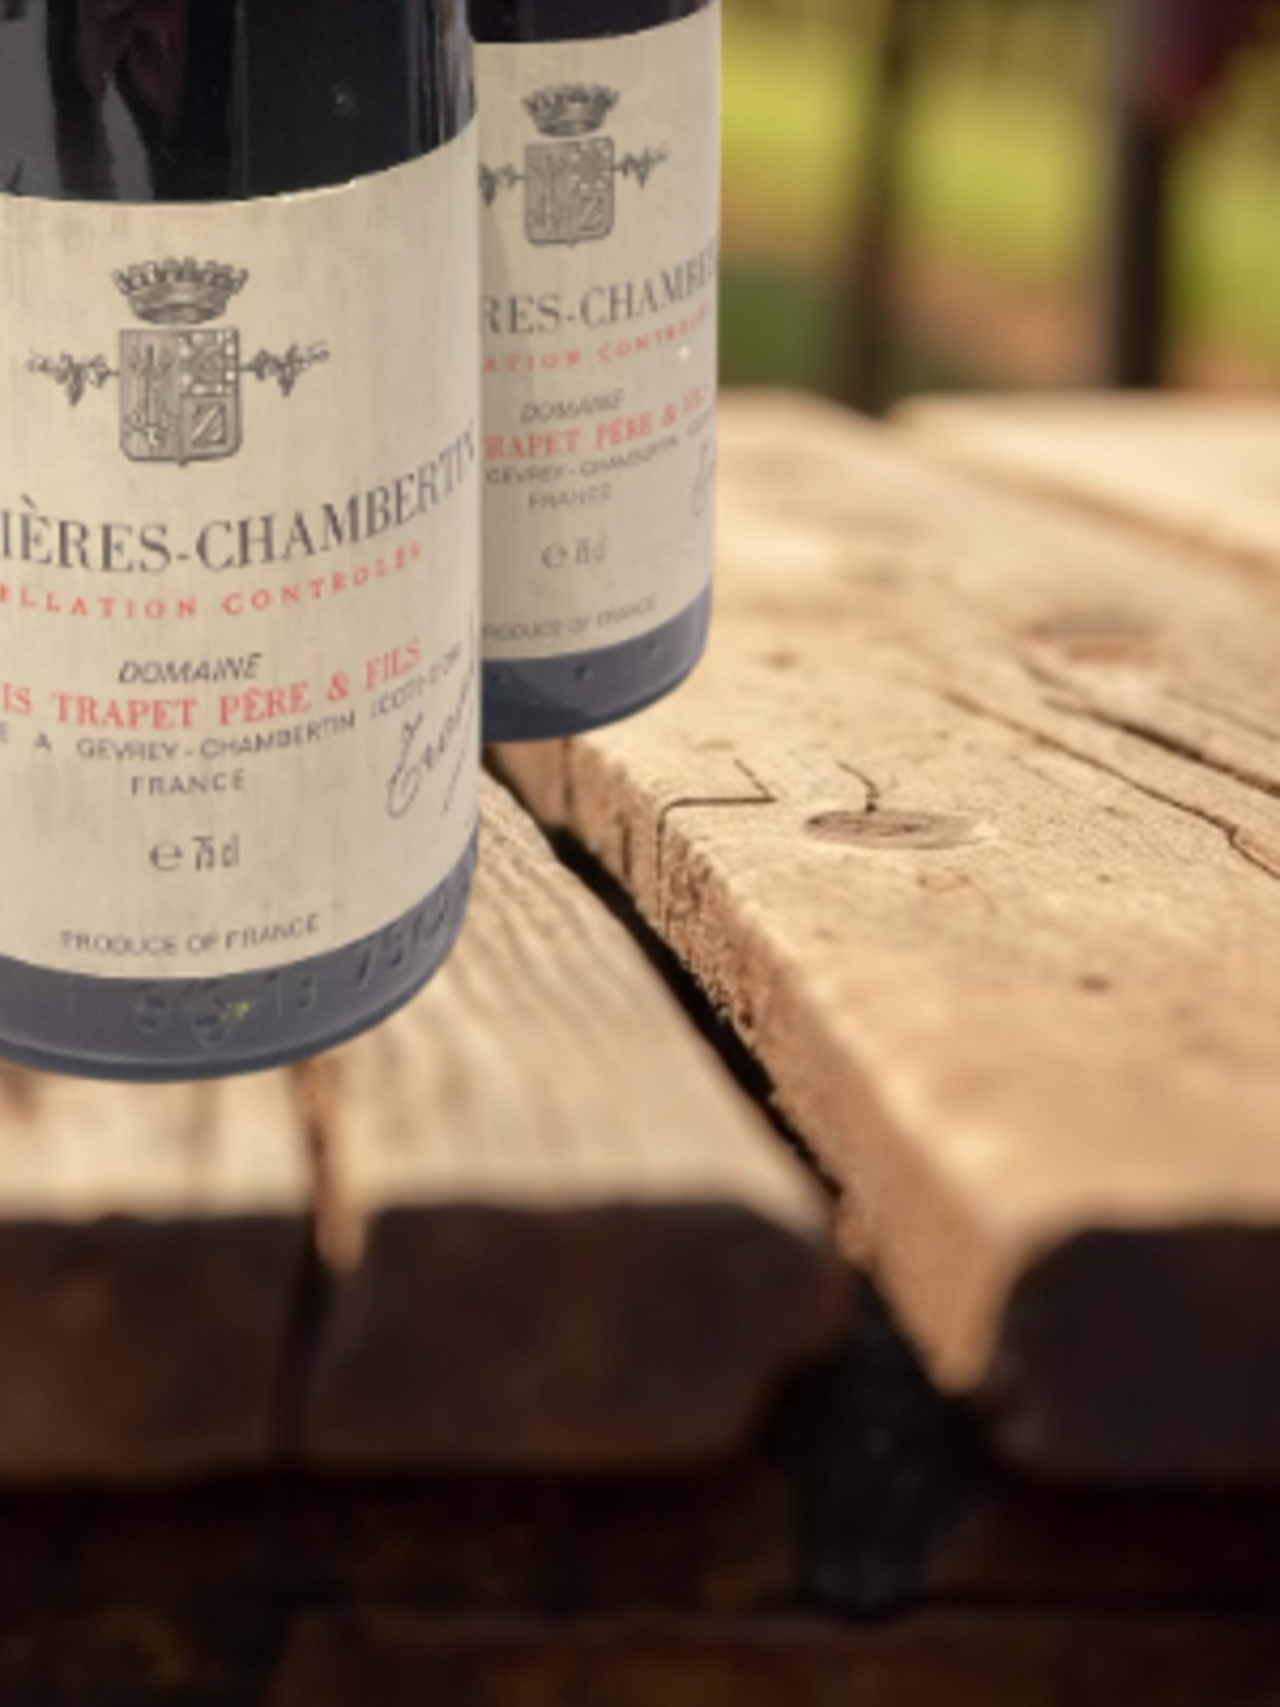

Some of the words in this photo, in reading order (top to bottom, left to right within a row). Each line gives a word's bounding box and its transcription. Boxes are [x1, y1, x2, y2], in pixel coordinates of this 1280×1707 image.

[528, 482, 611, 511] FRANCE
[51, 691, 198, 730] TRAPET
[326, 670, 352, 703] &
[365, 635, 423, 691] FILS
[118, 652, 263, 684] DOMAINE
[131, 767, 246, 797] FRANCE
[59, 928, 179, 957] PRODUCE
[186, 931, 220, 955] OF
[224, 911, 320, 951] FRANCE
